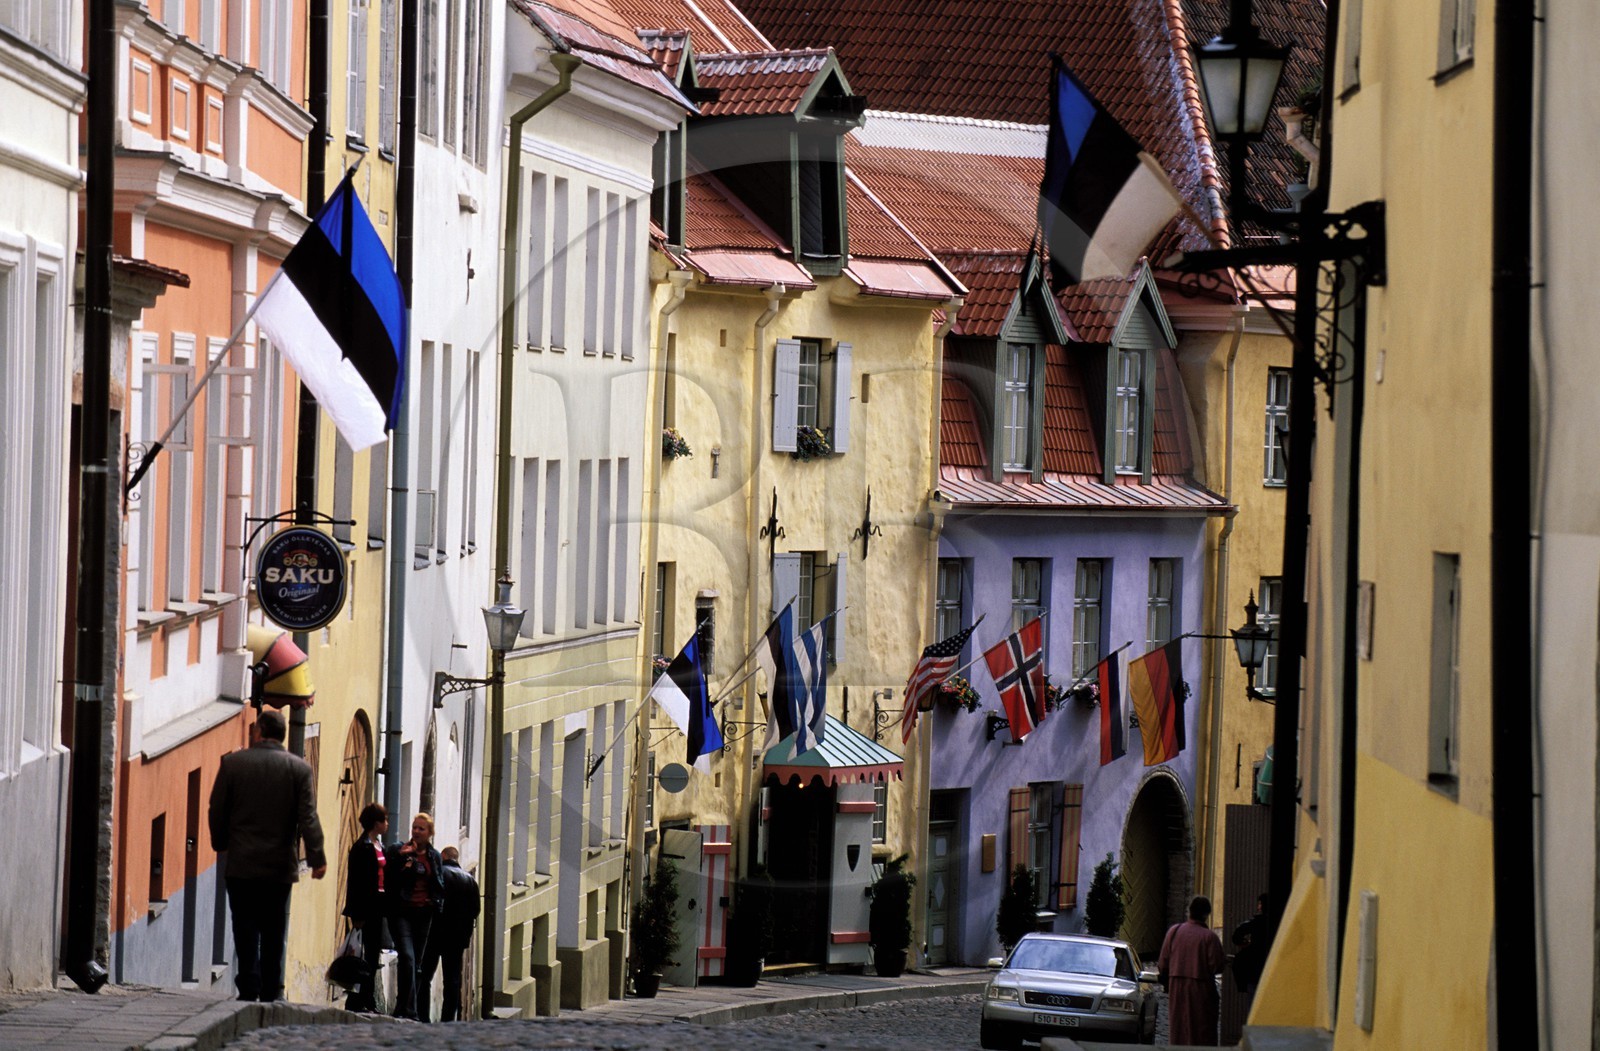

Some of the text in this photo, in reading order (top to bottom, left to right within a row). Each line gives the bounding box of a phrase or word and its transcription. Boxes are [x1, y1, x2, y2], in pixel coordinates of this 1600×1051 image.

[265, 567, 334, 584] SAKU
[279, 584, 320, 598] Originaal
[273, 603, 328, 621] PREMIUM LAGER
[1059, 1016, 1076, 1026] ESS
